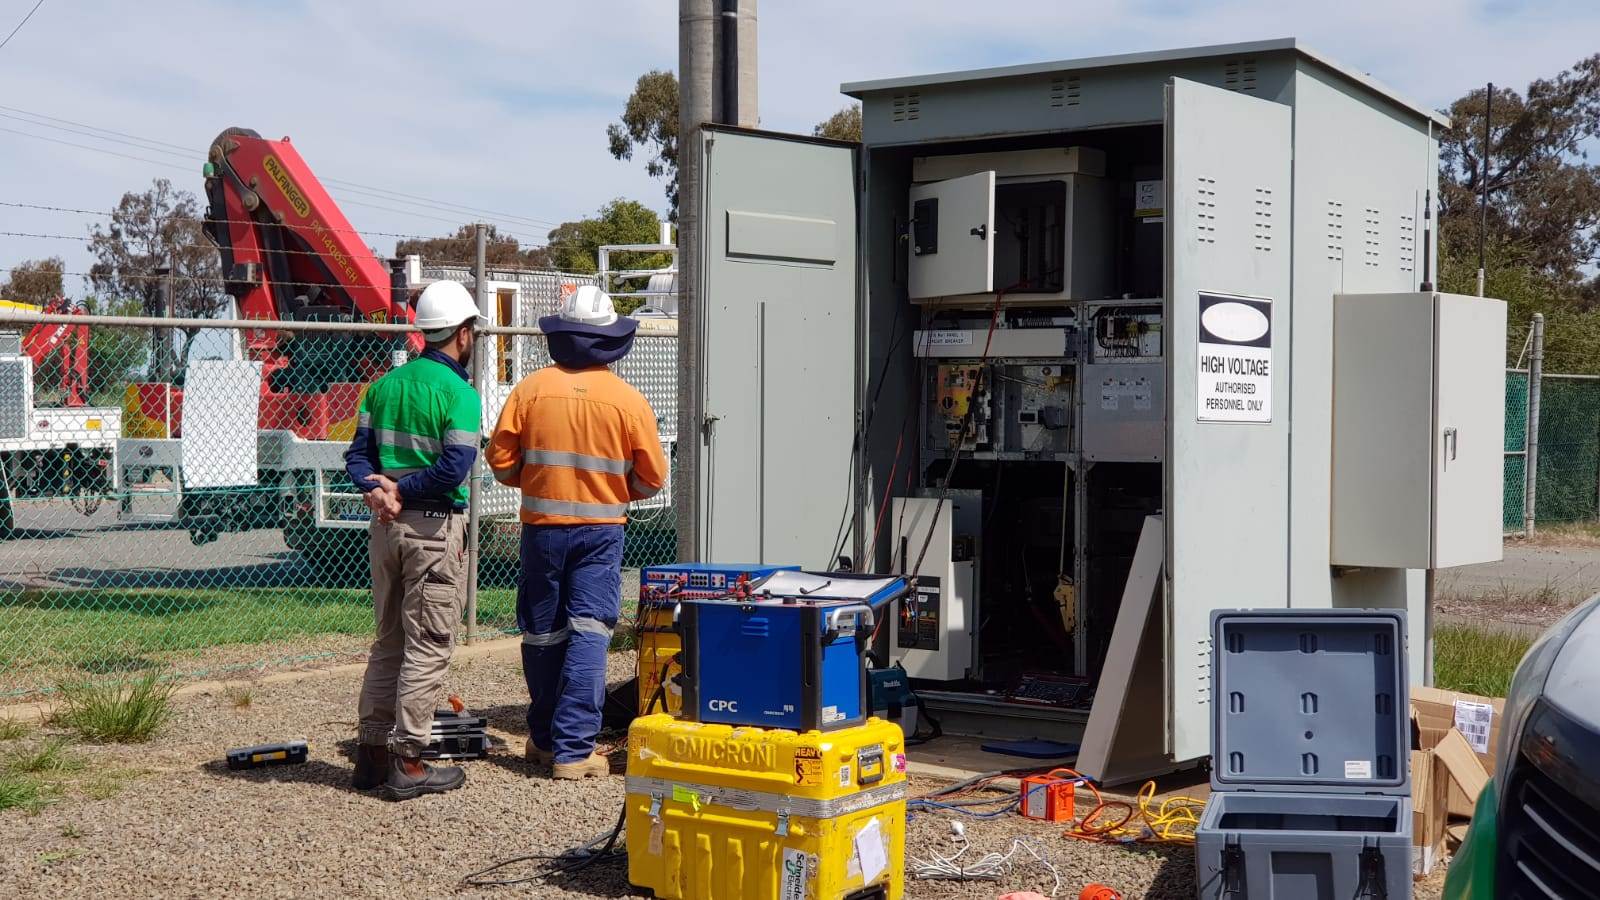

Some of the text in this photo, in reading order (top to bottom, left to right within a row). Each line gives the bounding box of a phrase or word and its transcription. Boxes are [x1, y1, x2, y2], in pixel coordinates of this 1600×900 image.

[265, 157, 307, 215] PALFINGER
[1201, 355, 1269, 377] HIGH VOLTAGE
[1214, 381, 1256, 395] AUTHORISED
[1206, 398, 1263, 411] PERSONNEL ONLY
[708, 699, 738, 713] CPC
[672, 735, 777, 769] OMICRON
